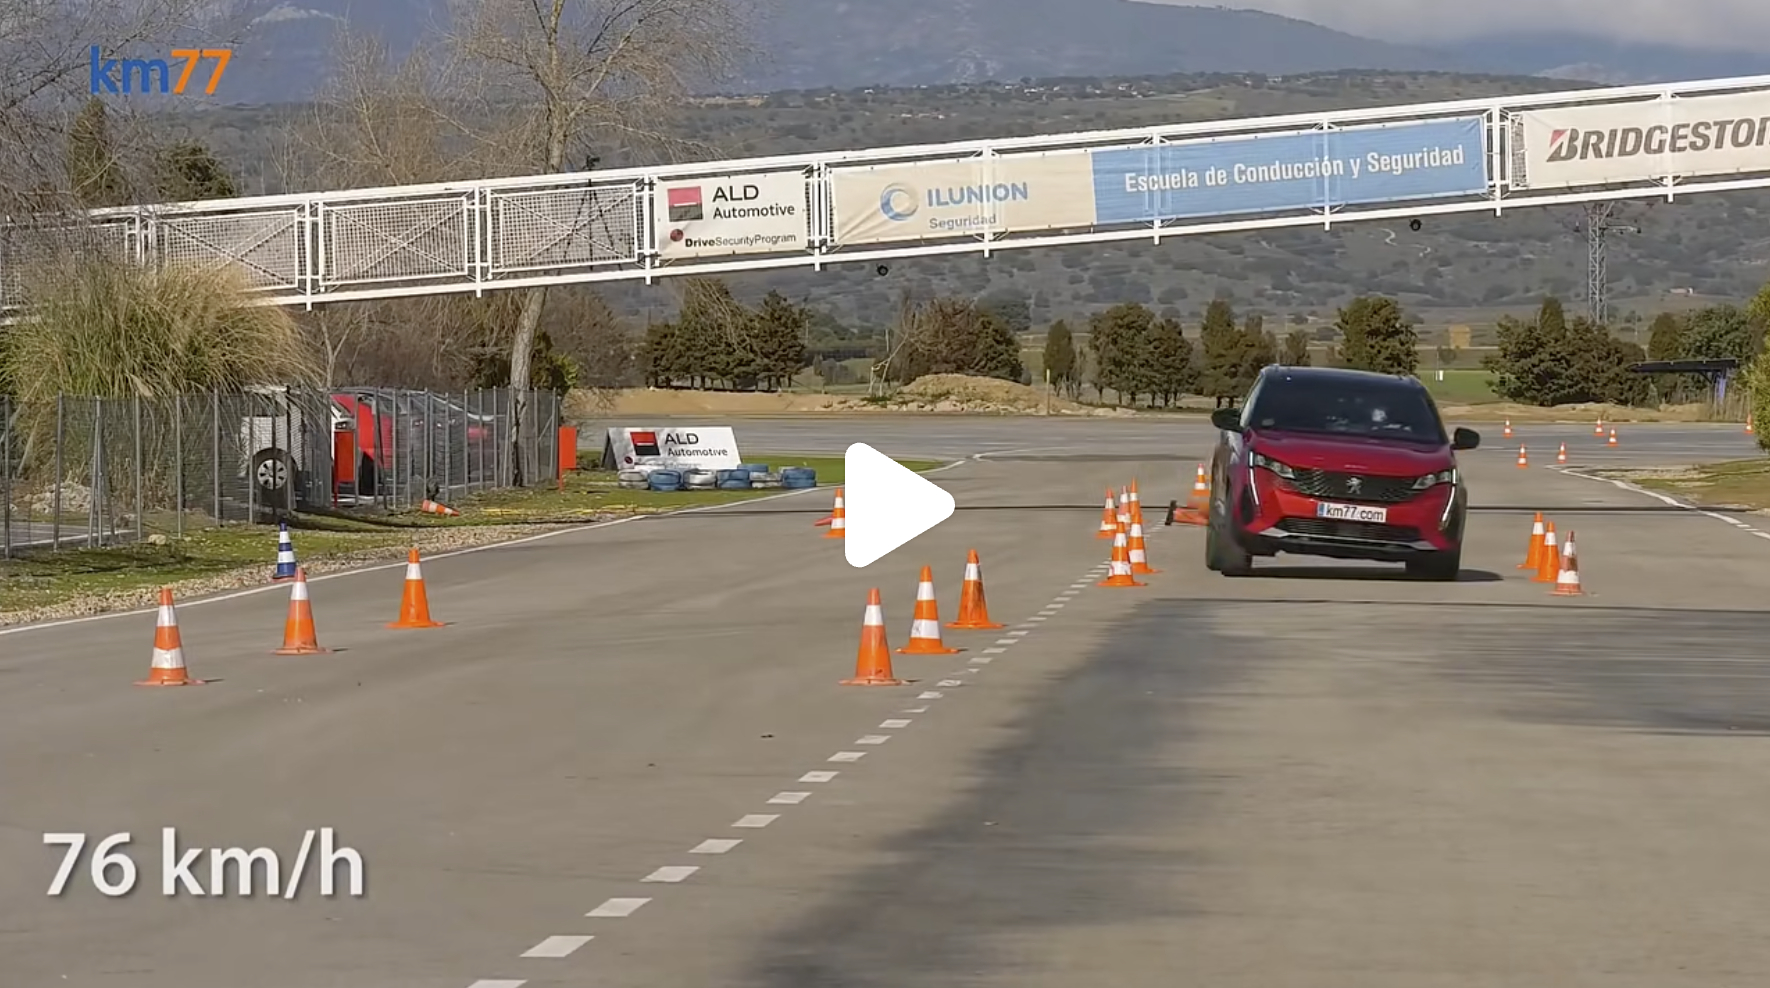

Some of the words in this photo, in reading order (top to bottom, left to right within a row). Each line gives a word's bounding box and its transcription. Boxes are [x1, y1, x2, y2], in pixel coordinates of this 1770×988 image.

[1125, 168, 1198, 192] Escuela
[1205, 166, 1228, 186] de
[1233, 156, 1344, 184] Conducción
[1350, 157, 1361, 179] y
[1367, 144, 1465, 175] Seguridad
[712, 184, 759, 202] ALD
[927, 182, 1028, 207] ILUNION
[713, 203, 795, 220] Automotive
[929, 214, 997, 230] Seguridad
[664, 433, 699, 445] ALD
[667, 447, 728, 457] Automotive
